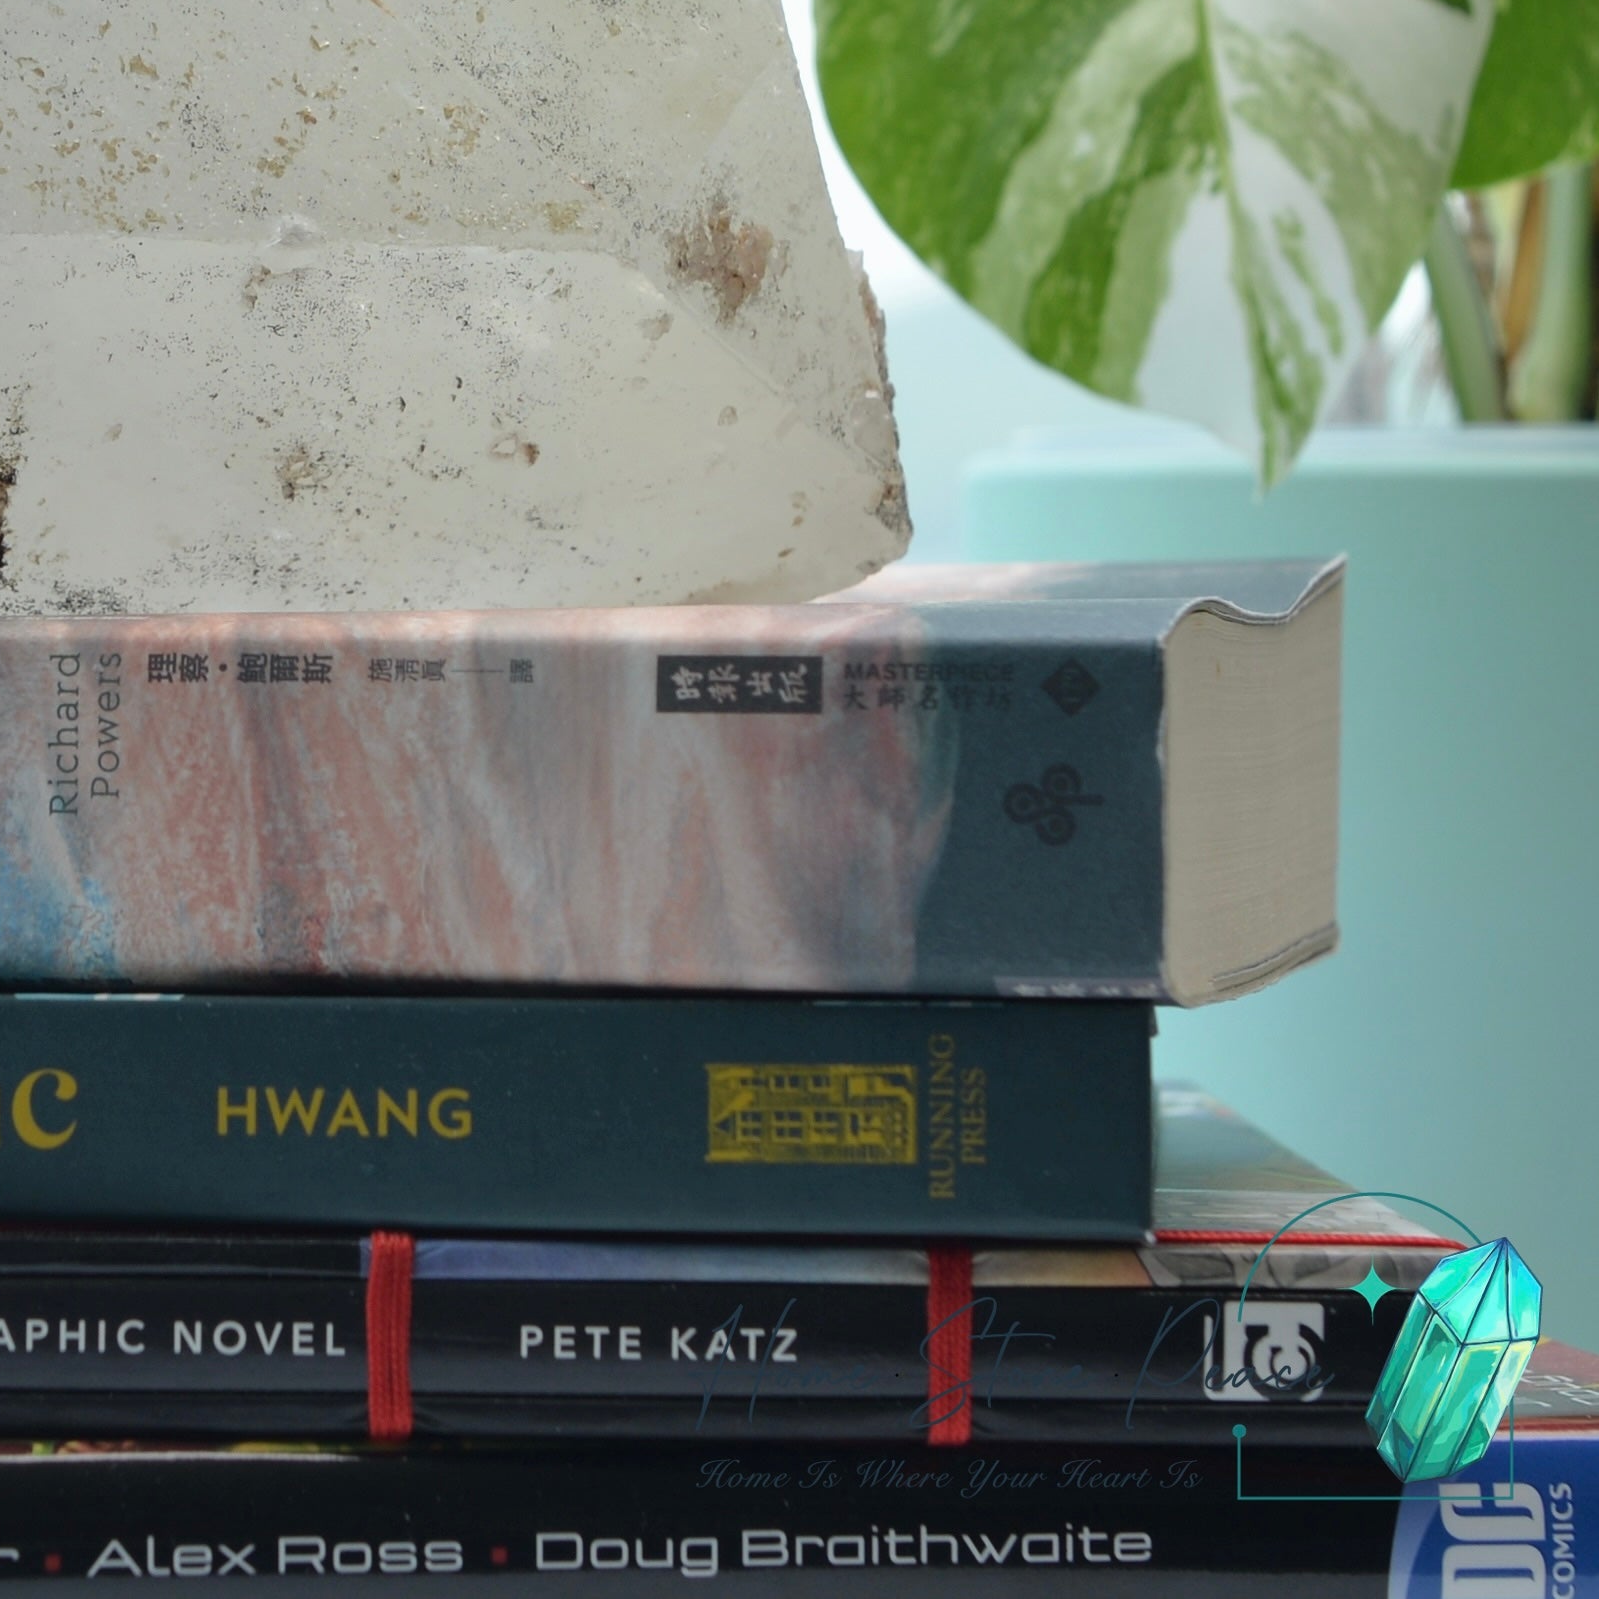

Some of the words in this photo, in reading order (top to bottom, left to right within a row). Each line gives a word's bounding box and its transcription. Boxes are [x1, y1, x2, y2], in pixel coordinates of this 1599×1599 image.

[843, 663, 1013, 682] MASTERPIECE
[48, 652, 81, 817] Richard
[90, 652, 122, 800] Powers
[216, 1086, 473, 1140] HWANG
[928, 1033, 956, 1198] RUNNING
[960, 1067, 988, 1165] PRESS
[173, 1320, 346, 1357] NOVEL
[520, 1326, 642, 1360] PETE
[670, 1328, 798, 1362] KATZ
[87, 1536, 257, 1577] Alex
[276, 1536, 465, 1574] Ross
[534, 1530, 720, 1578] Doug
[740, 1524, 1155, 1568] Braithwaite
[1438, 1482, 1547, 1599] DC
[1549, 1482, 1576, 1599] COMICS
